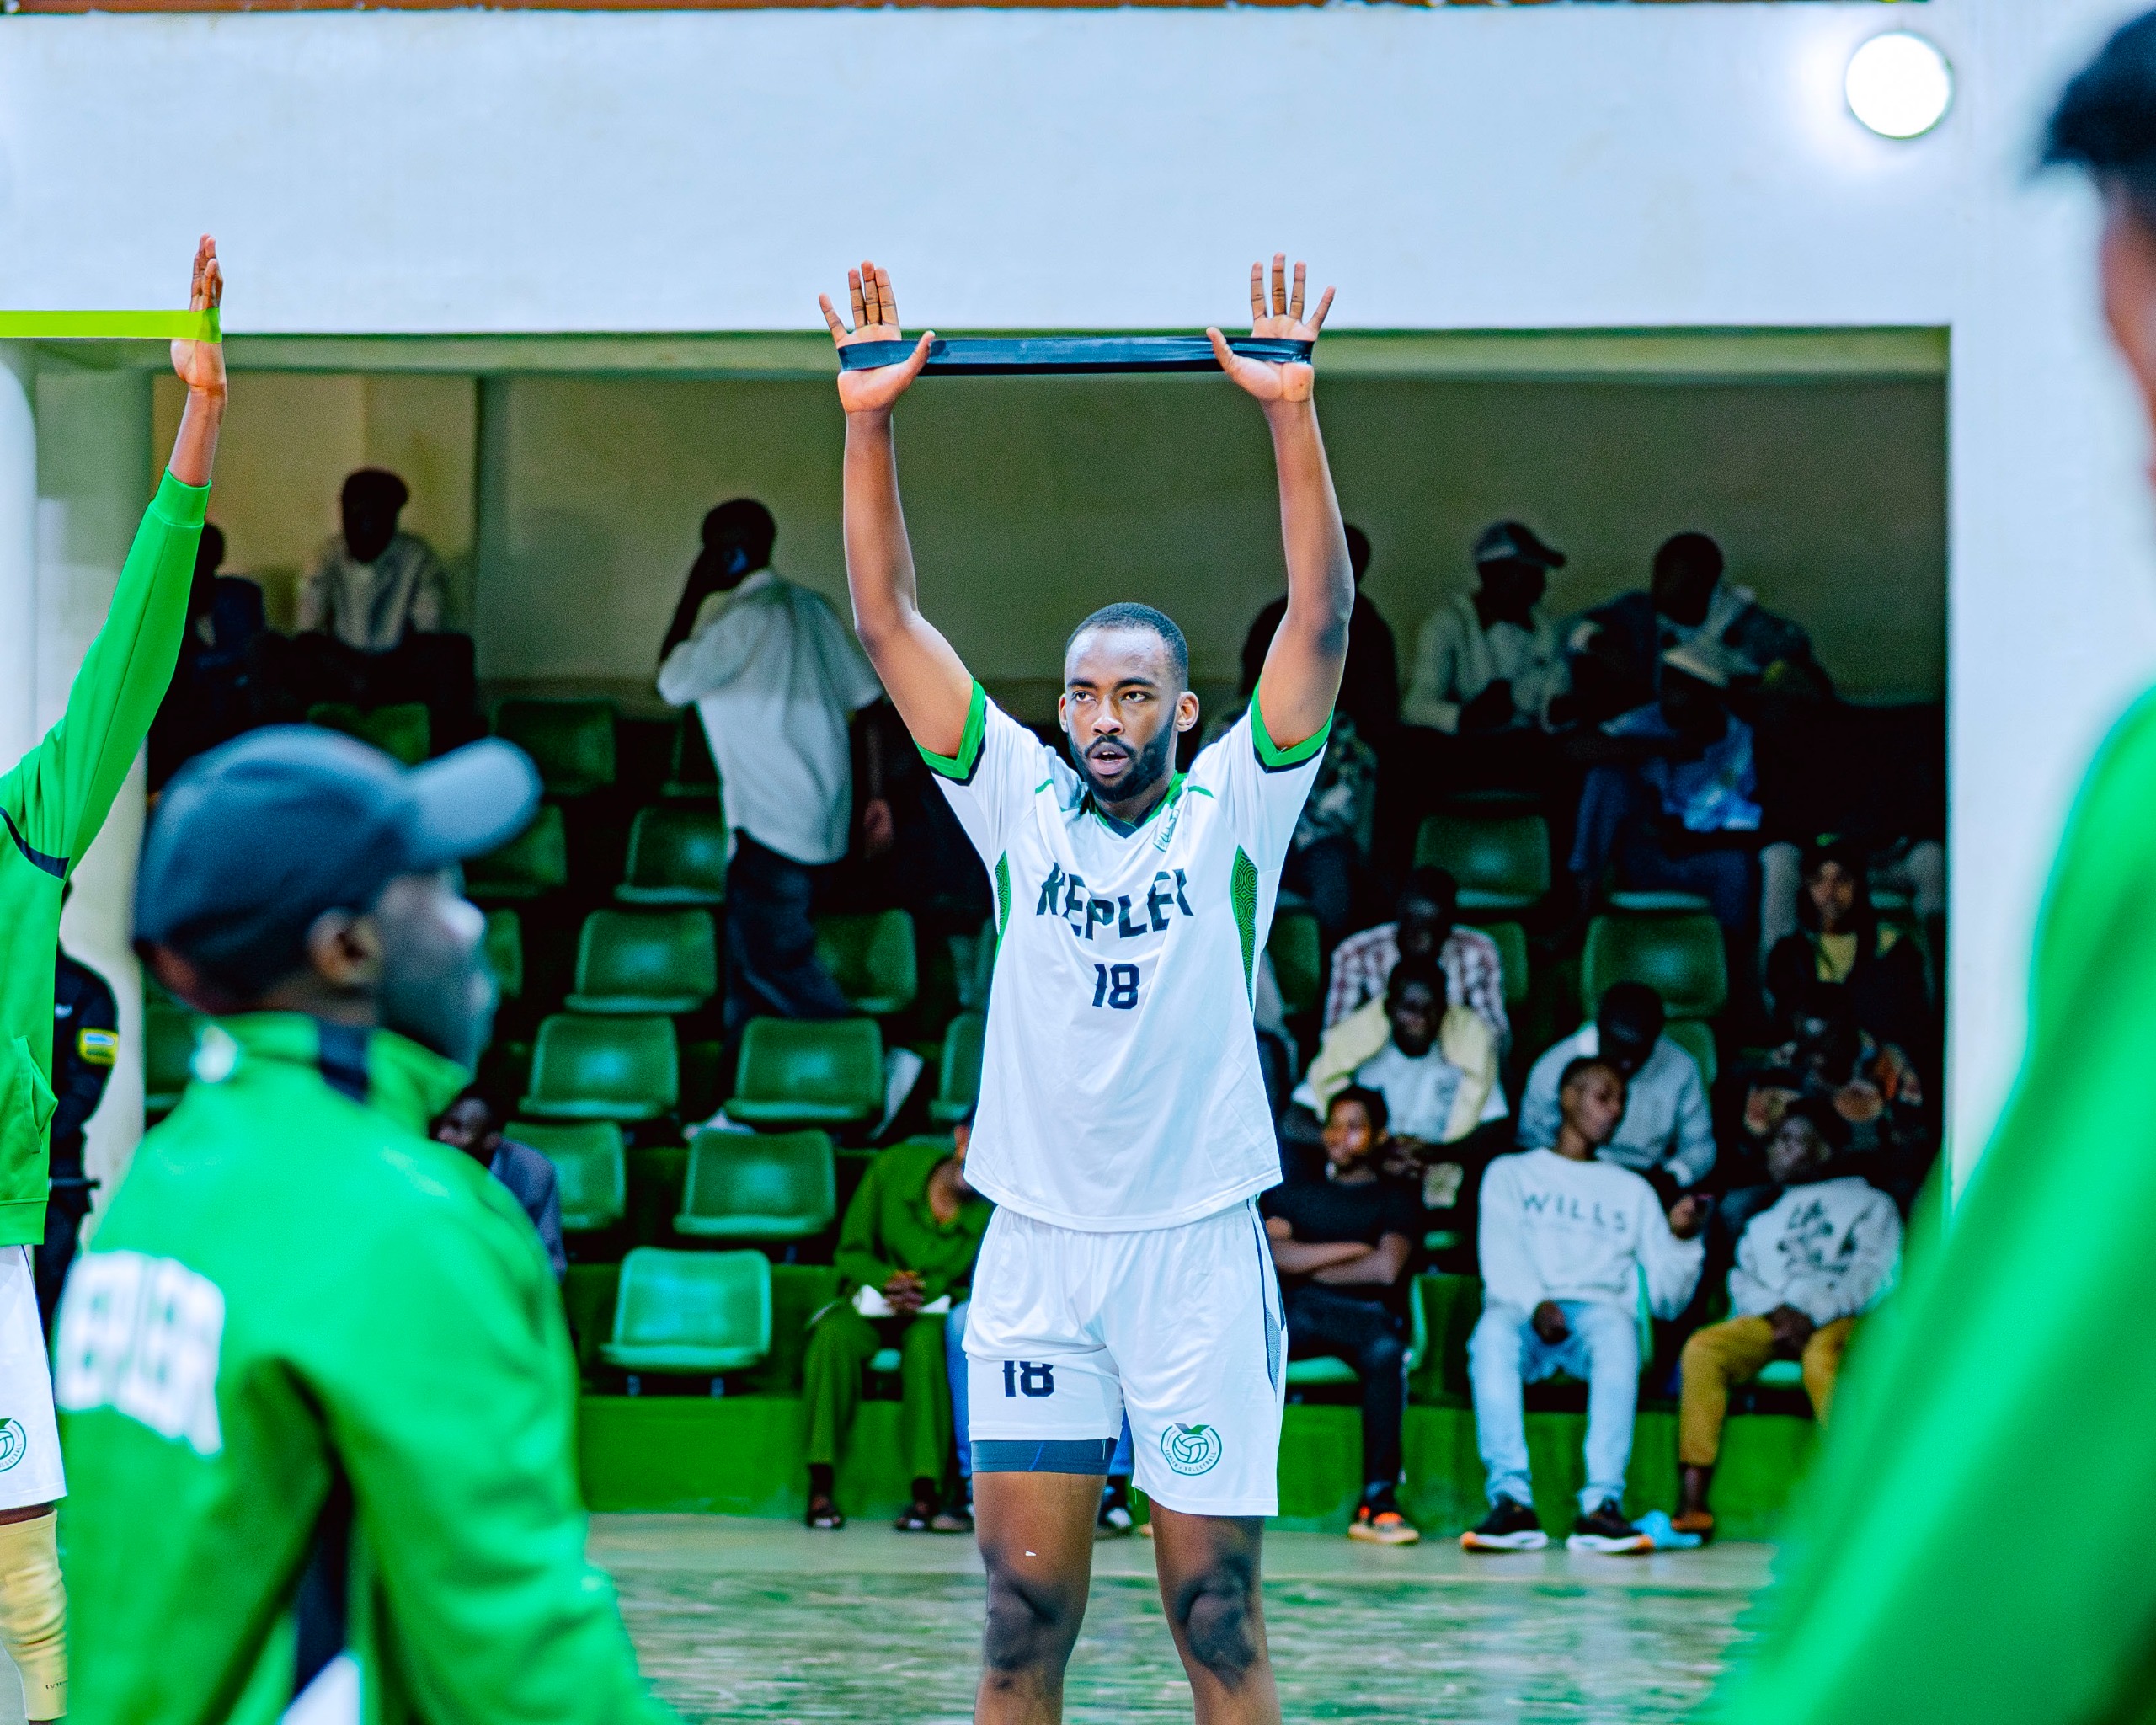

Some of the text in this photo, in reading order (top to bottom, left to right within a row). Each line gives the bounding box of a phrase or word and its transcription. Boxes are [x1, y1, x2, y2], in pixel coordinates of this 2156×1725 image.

[1091, 963, 1140, 1010] 18
[1522, 1191, 1628, 1233] WILLS
[1001, 1359, 1054, 1397] 18
